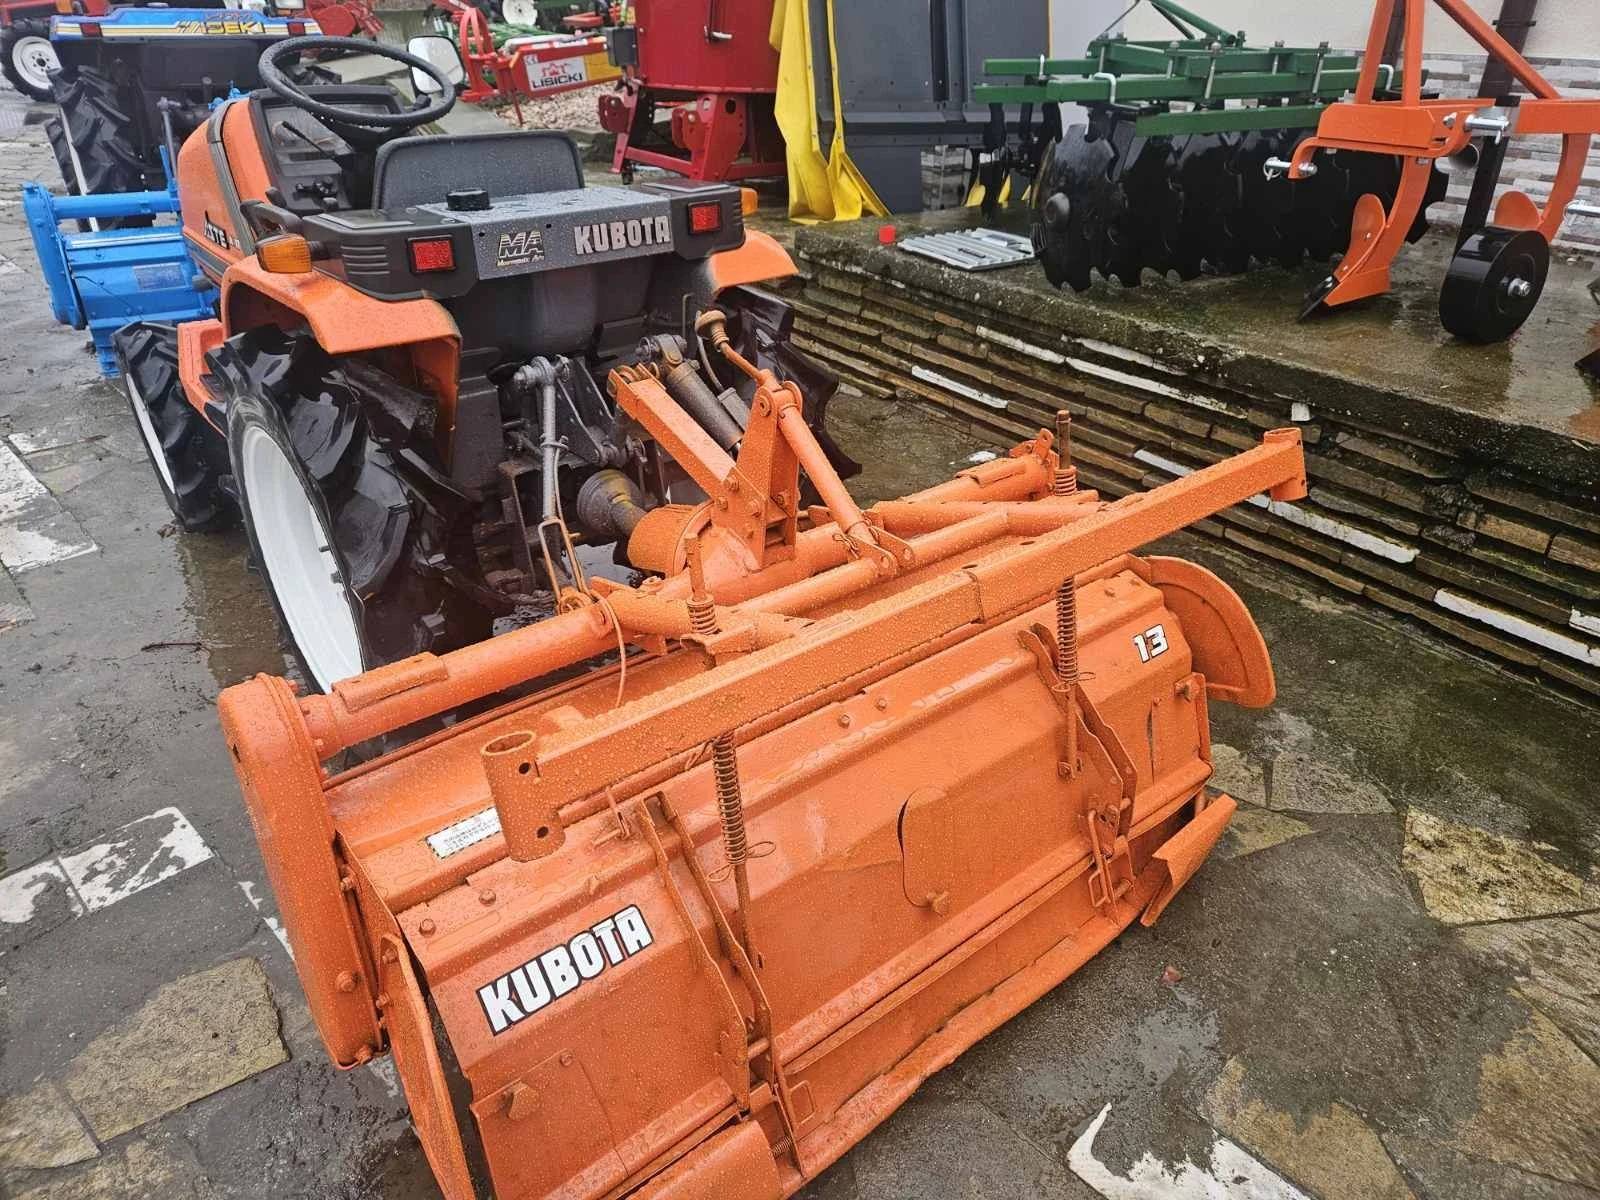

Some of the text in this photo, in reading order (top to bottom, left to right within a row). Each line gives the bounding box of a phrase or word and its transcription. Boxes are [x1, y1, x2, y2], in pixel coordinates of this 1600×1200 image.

[532, 72, 583, 88] LISICKI
[574, 215, 670, 255] KUBOTA
[1132, 624, 1169, 663] 13
[477, 904, 654, 1035] KUBOTA
